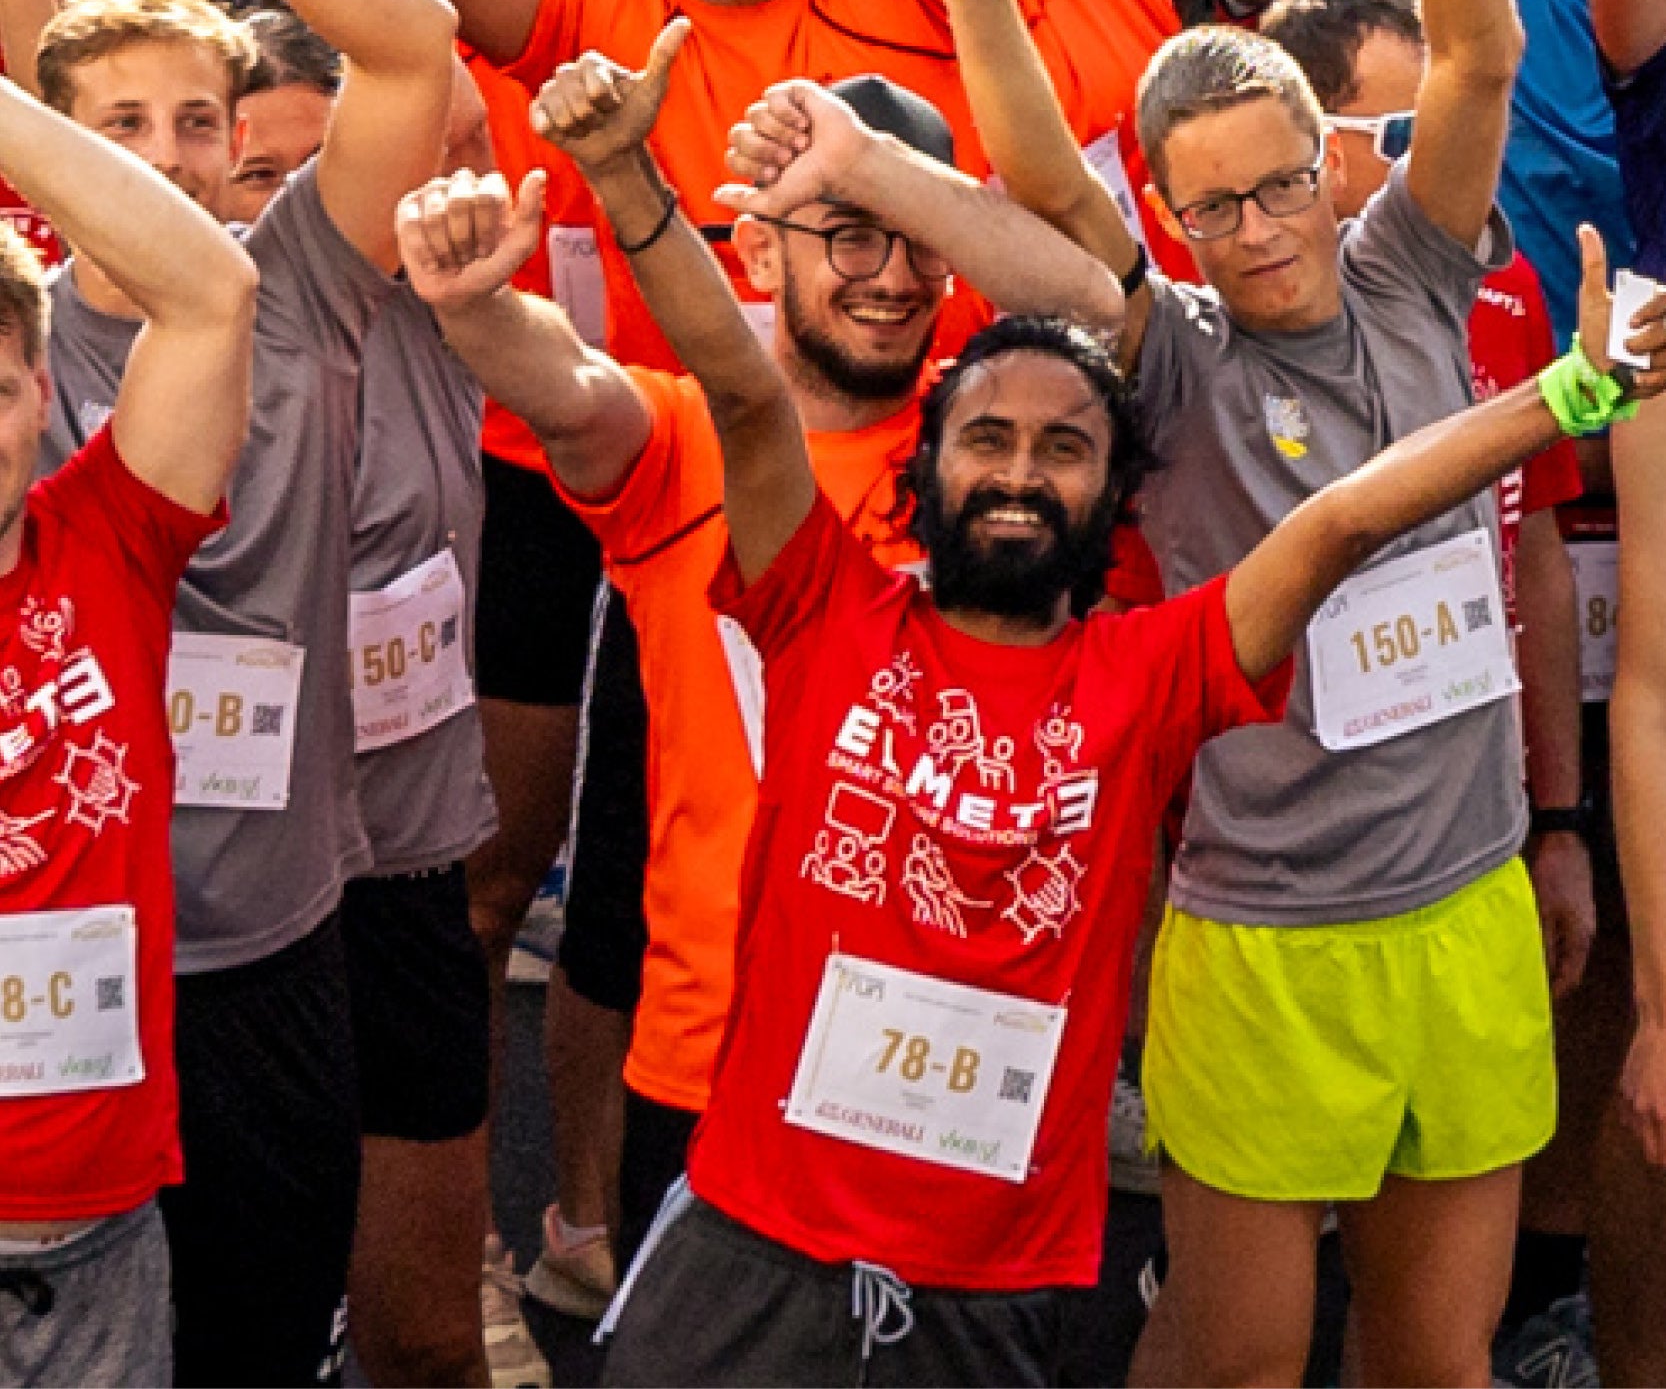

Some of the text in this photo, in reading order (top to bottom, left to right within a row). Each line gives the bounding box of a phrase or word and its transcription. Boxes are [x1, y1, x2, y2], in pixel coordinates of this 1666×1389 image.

[347, 620, 436, 687] 50-C
[1351, 600, 1460, 674] 150-A
[2, 973, 75, 1023] 8-C
[875, 1027, 982, 1095] 78-B
